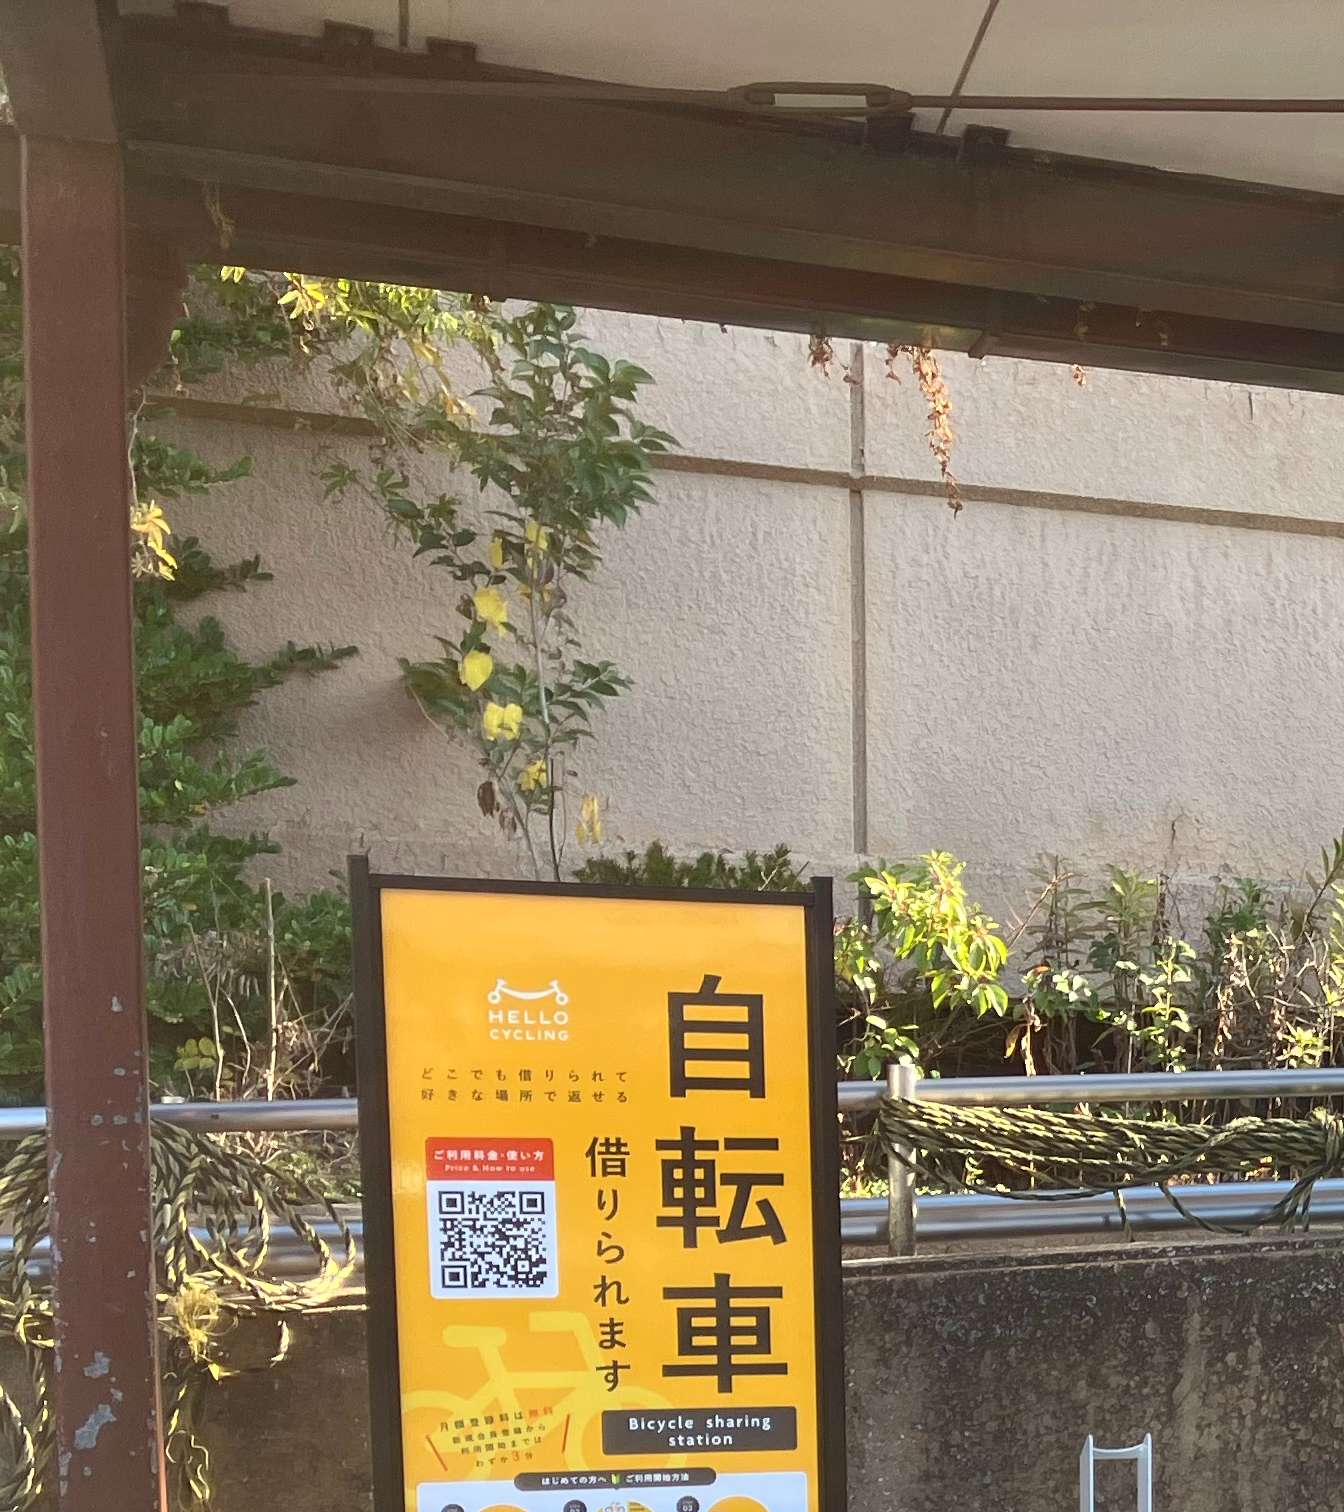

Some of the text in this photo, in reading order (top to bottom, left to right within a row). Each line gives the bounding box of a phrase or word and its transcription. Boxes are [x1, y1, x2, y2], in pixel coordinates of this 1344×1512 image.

[488, 1010, 569, 1026] HELLO
[489, 1029, 569, 1042] CYCLING
[421, 1067, 628, 1083] どこでも借りられて
[421, 1088, 628, 1103] 好きな場所で返せる
[482, 1164, 502, 1172] How
[506, 1164, 516, 1172] to
[655, 974, 788, 1393] 自転車
[585, 1136, 631, 1392] 借りられます
[629, 1415, 771, 1432] Bicycle sharing
[668, 1432, 733, 1447] station
[541, 1472, 690, 1486] はじめての方へ ご利用開始方法
